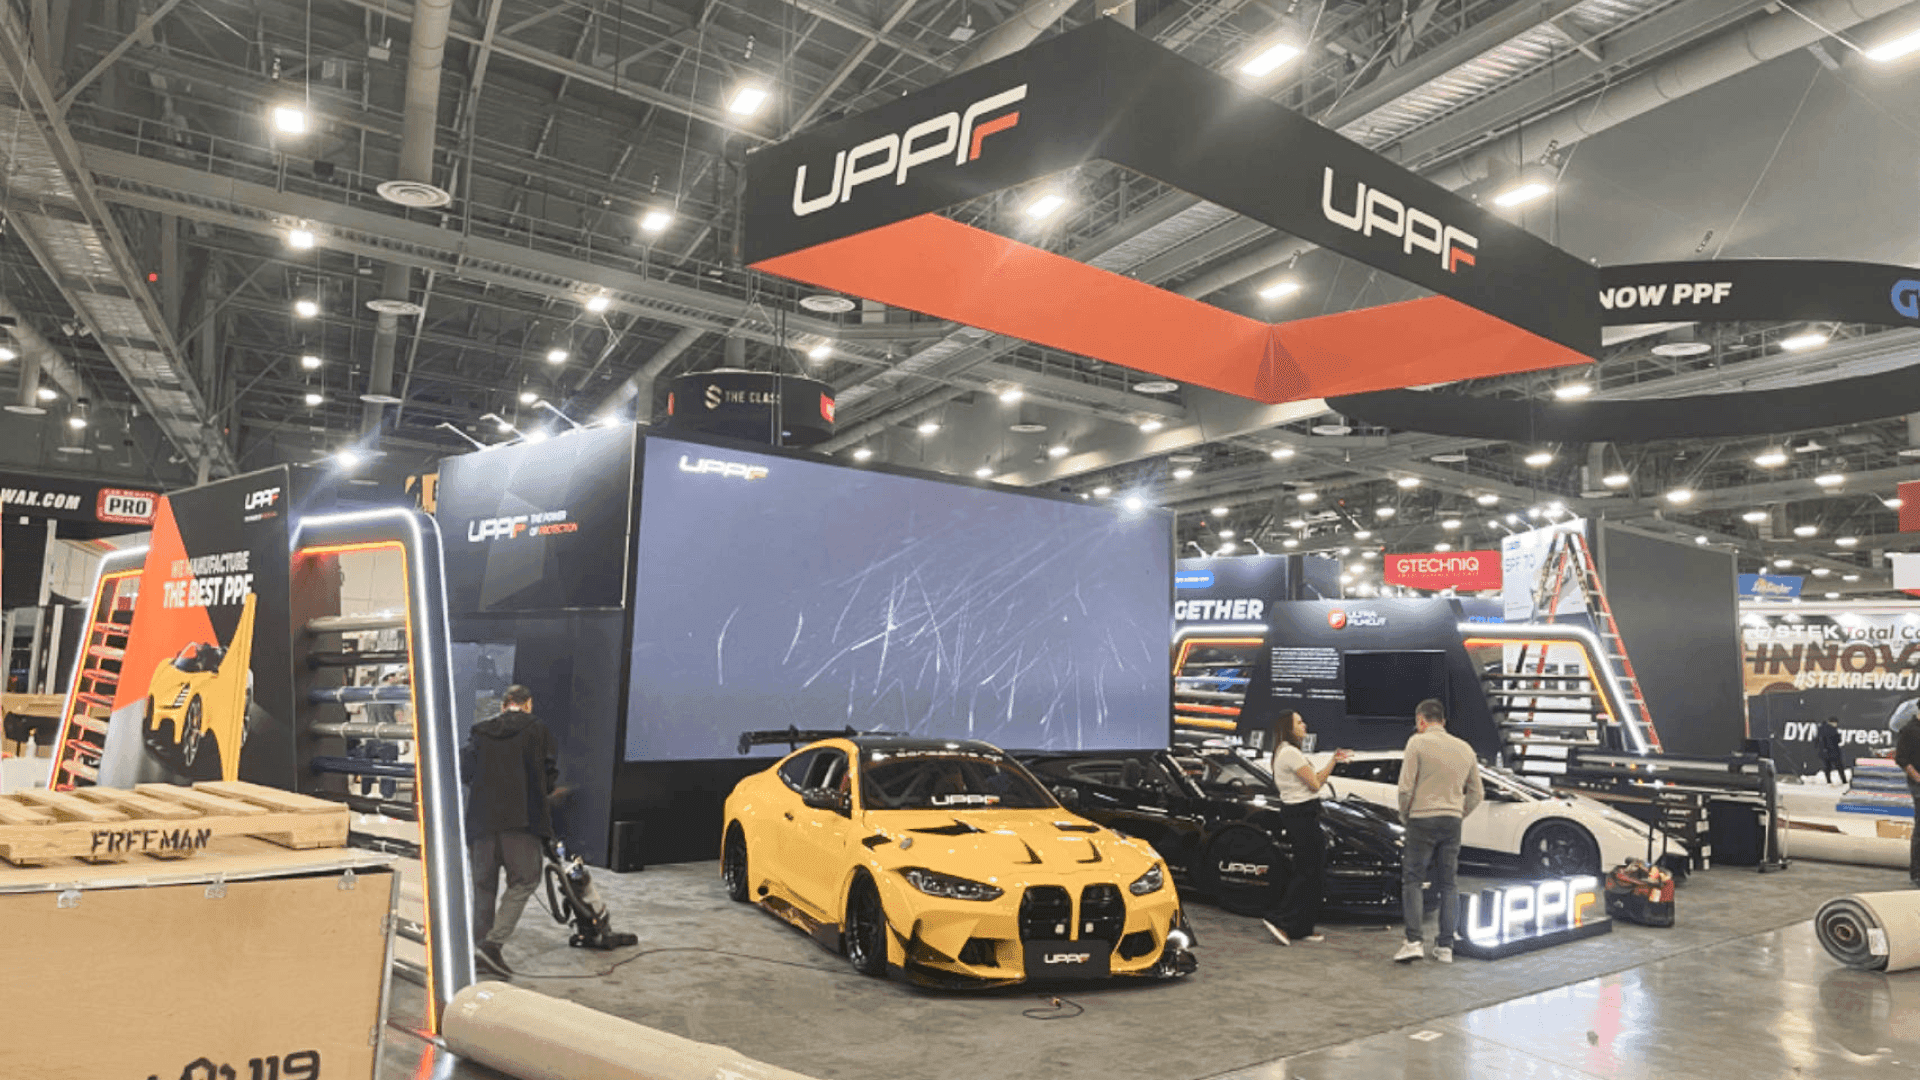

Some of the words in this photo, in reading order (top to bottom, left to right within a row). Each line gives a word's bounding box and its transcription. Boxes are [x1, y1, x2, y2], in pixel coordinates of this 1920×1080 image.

[793, 84, 1028, 217] UPPF
[1322, 166, 1478, 274] UPPF
[1672, 282, 1733, 306] PPF
[725, 390, 745, 403] THE
[678, 454, 770, 481] UPPF
[1, 488, 82, 510] WAX.COM
[109, 497, 147, 515] PRO
[244, 487, 281, 510] UPPF
[467, 515, 529, 543] UPPF
[186, 550, 250, 576] MANUFACTURE
[1396, 556, 1480, 573] GTECHNIQ
[163, 579, 187, 609] THE
[188, 576, 223, 608] BEST
[222, 572, 254, 606] PPF
[1775, 624, 1841, 641] STEK
[930, 794, 1000, 806] UPPF
[90, 828, 212, 853] FREEMAN
[1218, 860, 1269, 876] UPPF
[1466, 875, 1598, 948] UPPF
[1043, 952, 1091, 964] UPPF
